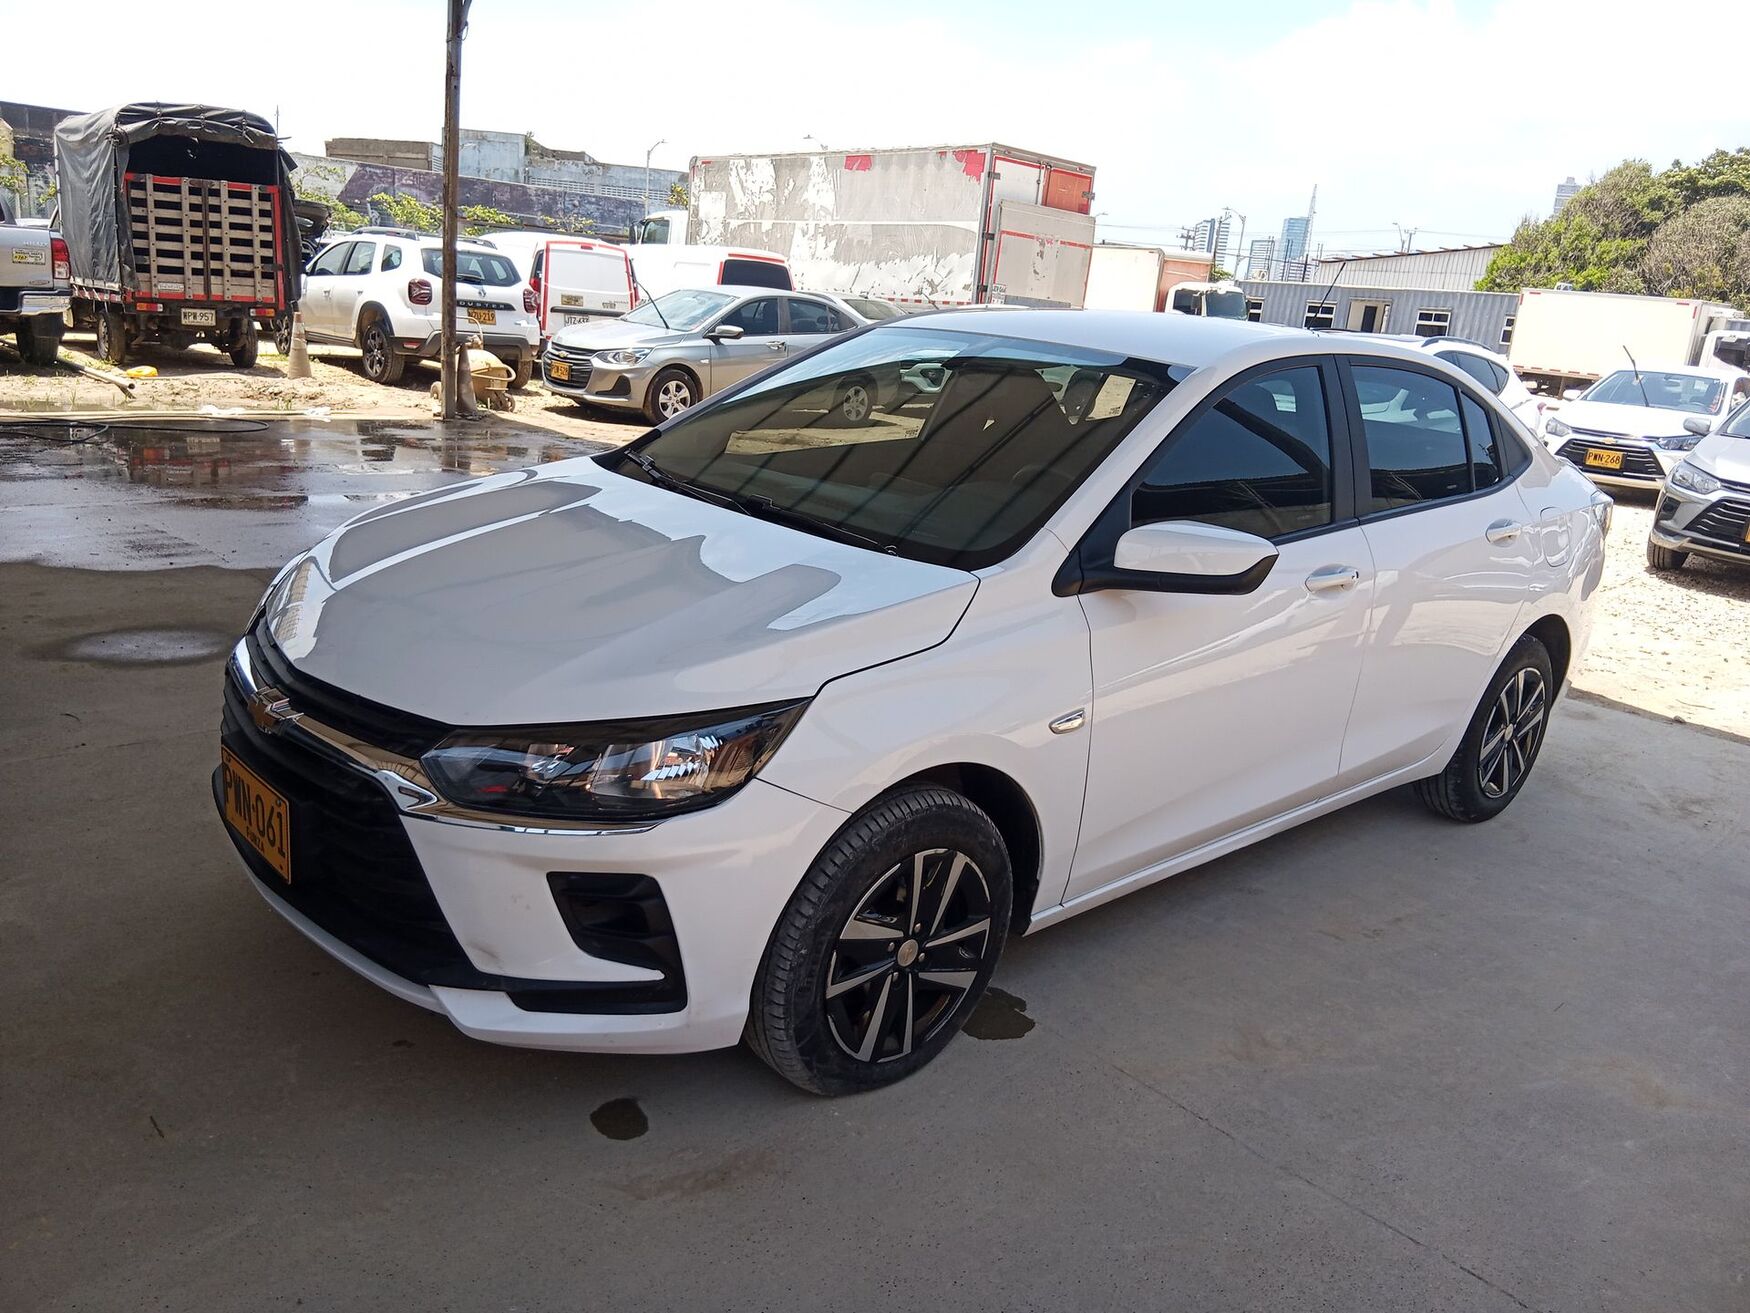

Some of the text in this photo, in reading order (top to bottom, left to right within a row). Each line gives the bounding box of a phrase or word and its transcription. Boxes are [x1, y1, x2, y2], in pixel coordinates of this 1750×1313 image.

[460, 301, 505, 309] DUSTER
[1588, 452, 1621, 465] PWN-268
[222, 763, 286, 858] PWN-061
